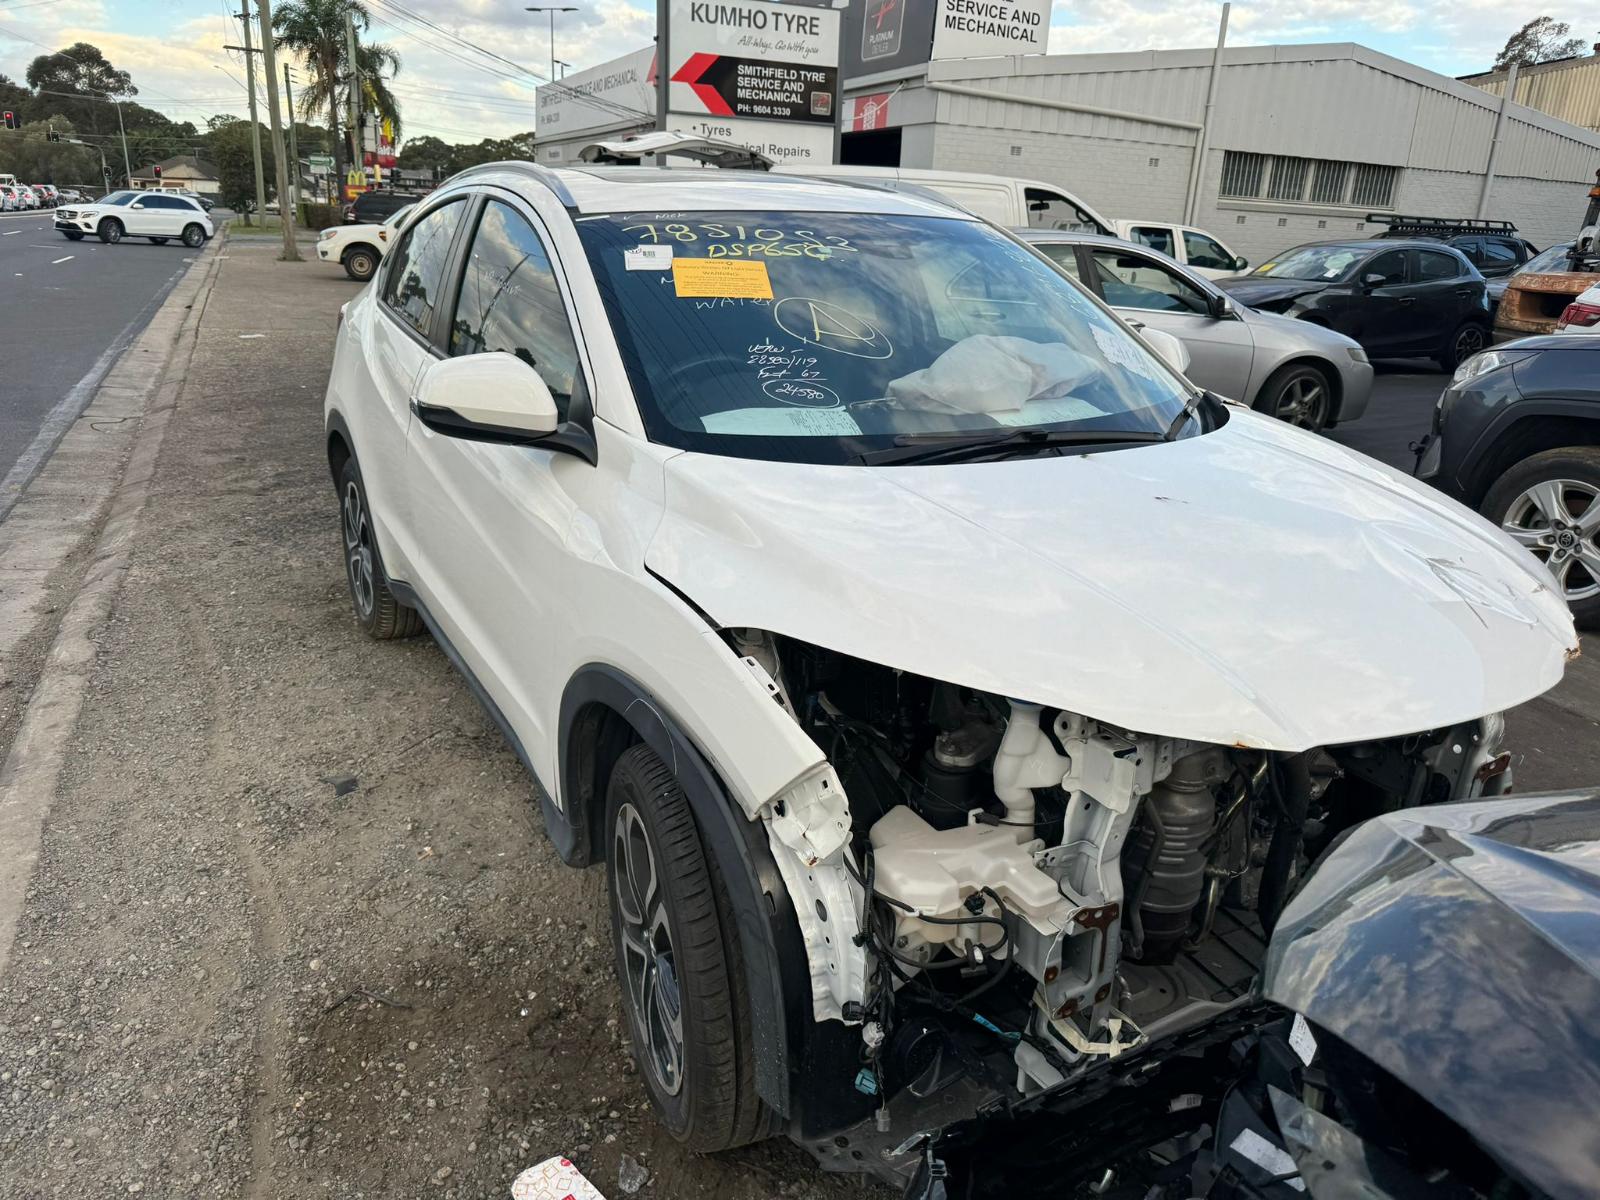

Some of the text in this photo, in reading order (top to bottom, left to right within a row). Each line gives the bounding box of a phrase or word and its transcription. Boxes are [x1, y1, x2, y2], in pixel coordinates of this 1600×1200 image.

[691, 2, 820, 36] KUMHO TYRE
[946, 0, 1041, 26] SERVICE AND
[945, 15, 1037, 43] MECHANICAL
[737, 65, 826, 83] SMITHFIELD TYRE
[737, 77, 805, 92] SERVICE AND
[737, 88, 804, 104] MECHANICAL
[737, 103, 791, 117] PH: 9604 3330
[700, 123, 732, 138] Tyres
[769, 144, 811, 158] Repairs
[775, 383, 824, 399] 24580
